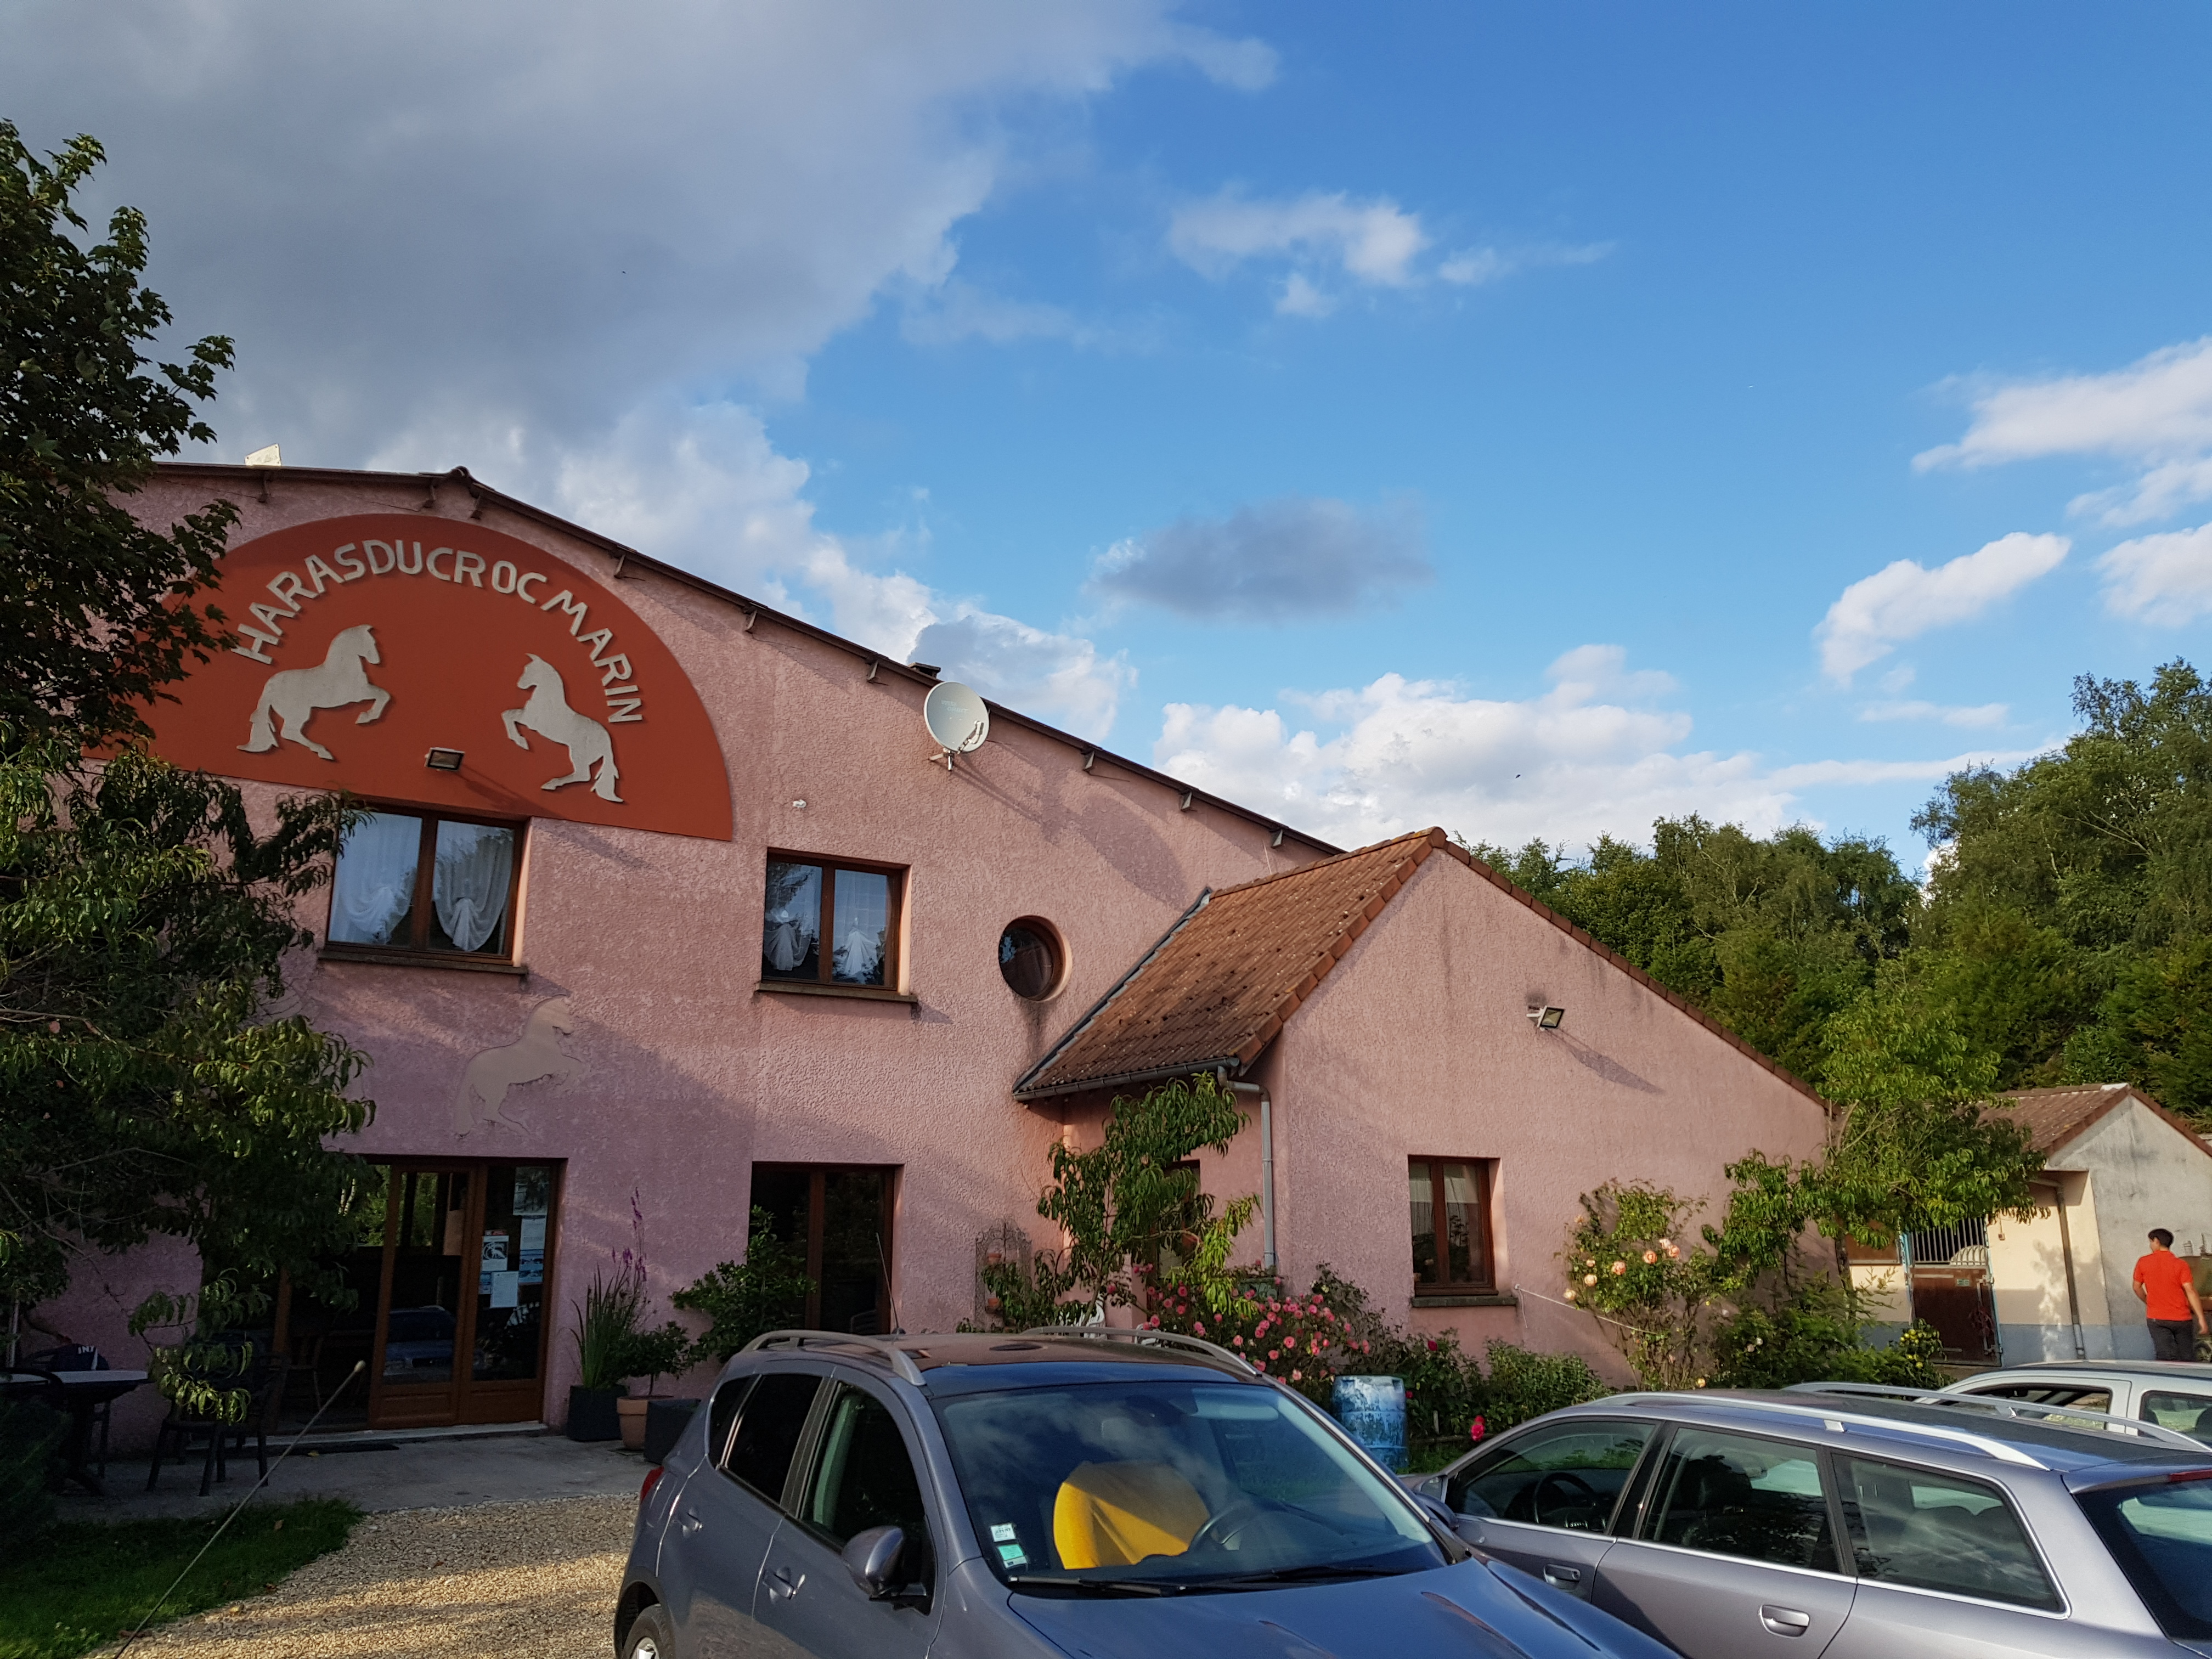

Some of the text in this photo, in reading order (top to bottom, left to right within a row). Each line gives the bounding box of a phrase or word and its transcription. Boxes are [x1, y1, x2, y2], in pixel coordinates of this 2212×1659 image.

[231, 539, 643, 723] HARAS DU CROC MARIN
